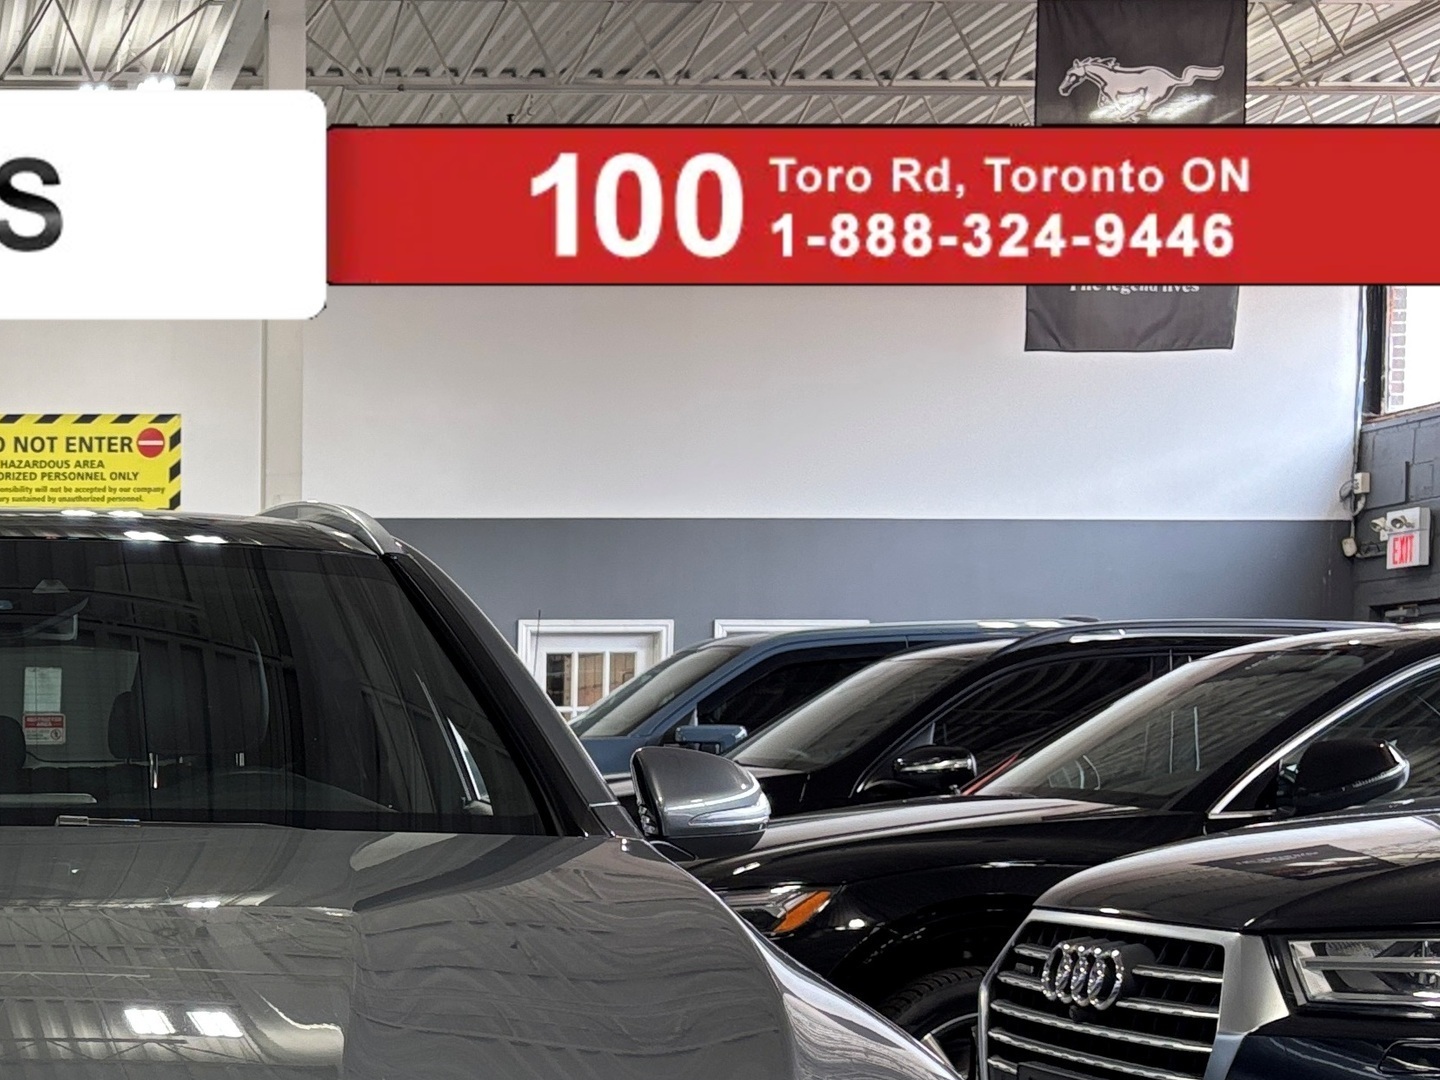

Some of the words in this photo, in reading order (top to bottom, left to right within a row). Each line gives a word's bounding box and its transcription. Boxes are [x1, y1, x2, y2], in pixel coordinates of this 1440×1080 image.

[13, 436, 58, 454] NOT
[65, 436, 134, 454] ENTER
[0, 459, 71, 469] HAZARDOUS
[74, 459, 105, 469] AREA
[40, 471, 107, 482] PERSONNEL
[109, 471, 140, 482] ONLY
[1392, 534, 1415, 565] EXIT
